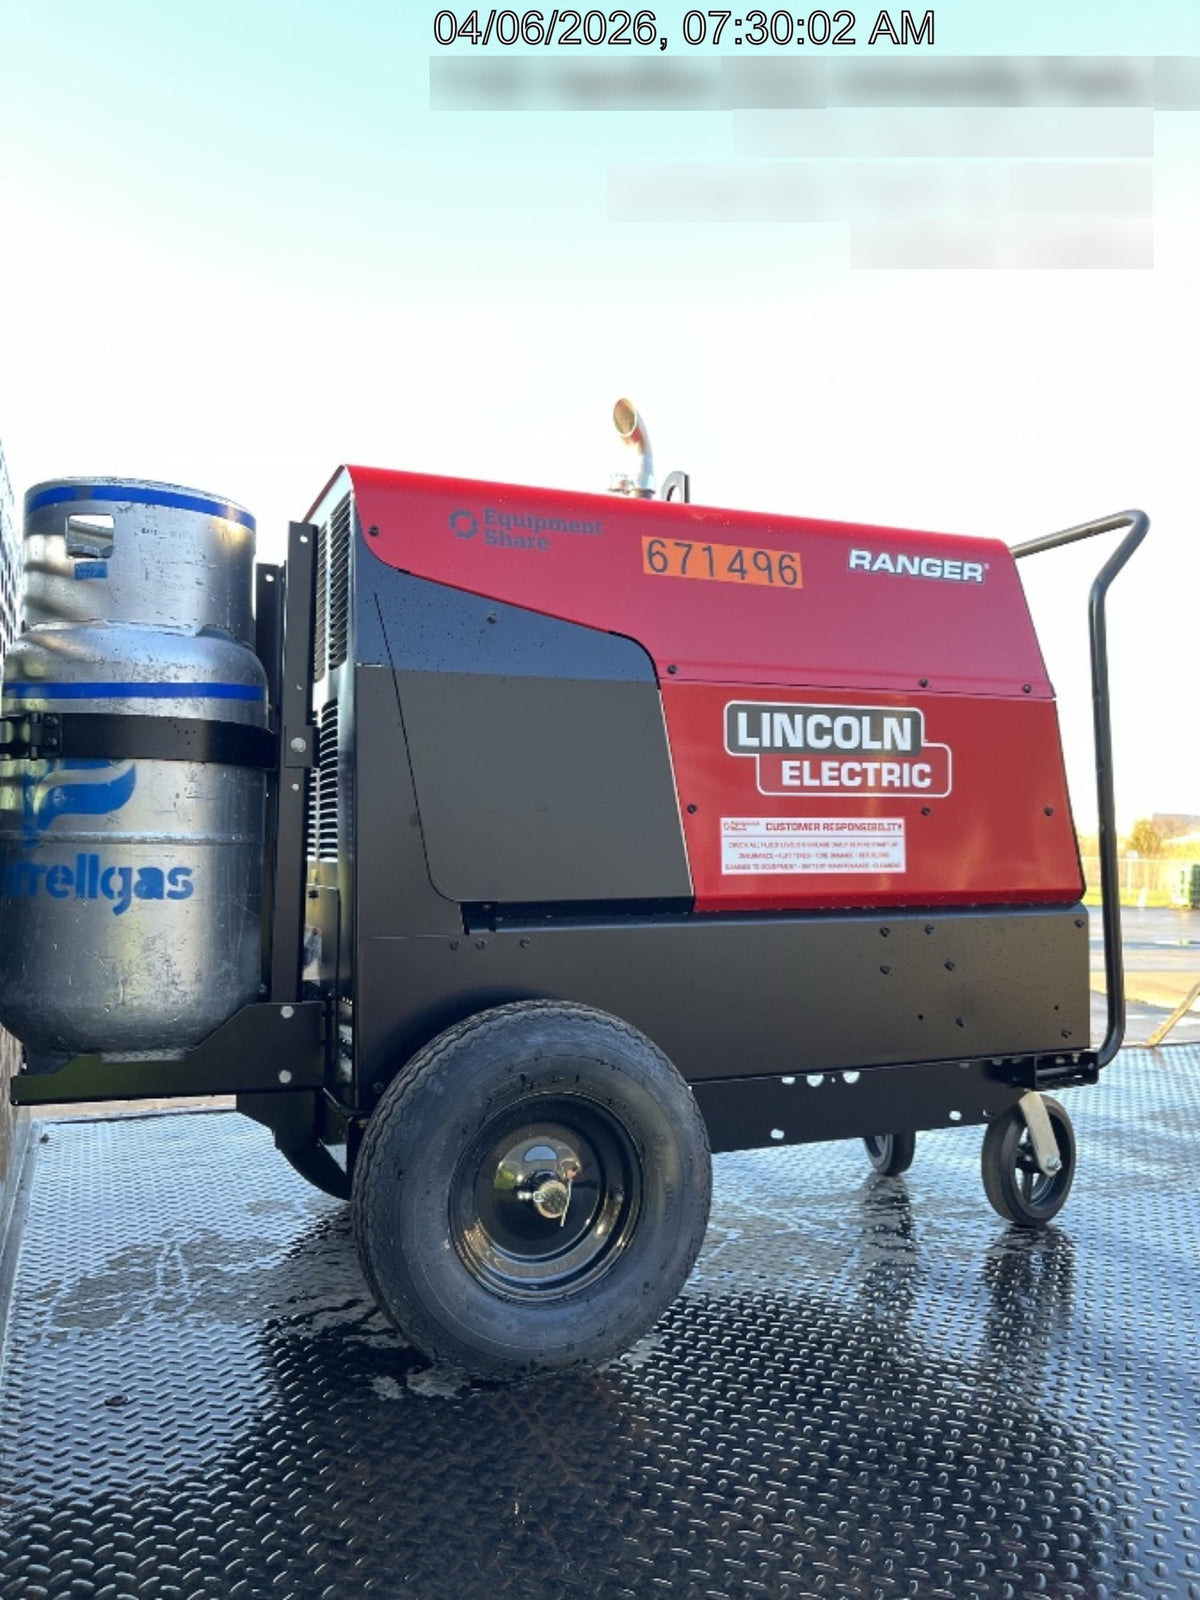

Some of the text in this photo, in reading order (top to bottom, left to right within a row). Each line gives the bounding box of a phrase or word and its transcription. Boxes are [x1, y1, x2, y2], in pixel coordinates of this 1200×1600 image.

[483, 508, 604, 536] Equipment
[484, 529, 549, 551] Share
[646, 539, 798, 586] 671496
[849, 548, 984, 583] RANGER
[737, 712, 912, 751] LINCOLN
[781, 760, 932, 788] ELECTRIC
[765, 822, 820, 831] CUSTOMER
[822, 822, 902, 831] RESPONSIBILITY
